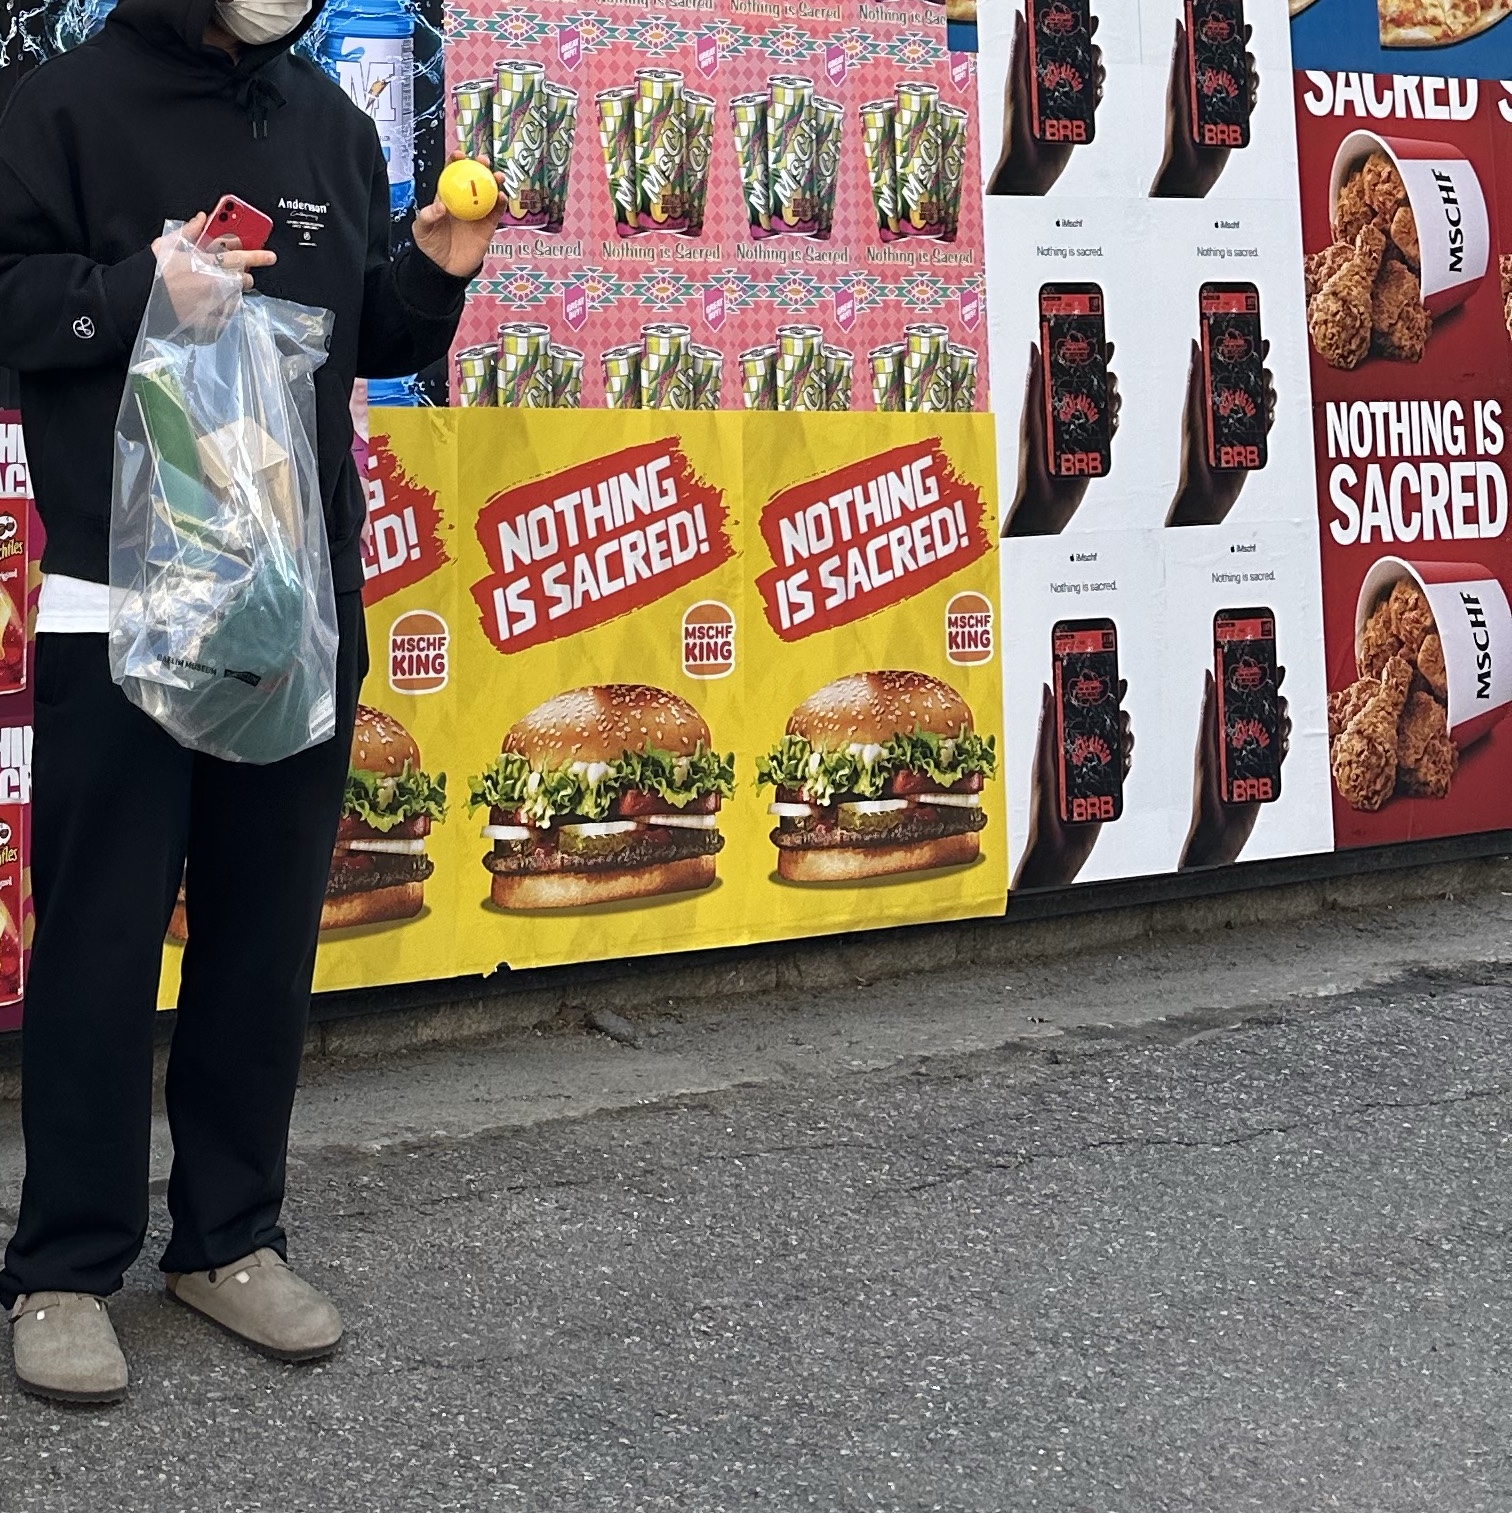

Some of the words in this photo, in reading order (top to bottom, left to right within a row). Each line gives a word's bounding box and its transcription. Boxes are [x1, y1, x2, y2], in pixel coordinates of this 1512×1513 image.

[784, 0, 796, 18] is
[796, 1, 842, 22] Sacred
[1304, 70, 1479, 121] SACRED
[1045, 119, 1086, 142] BRB
[1430, 168, 1465, 274] MSCHF
[603, 241, 658, 263] Nothing
[659, 244, 671, 262] is
[671, 242, 721, 263] Sacred
[1036, 245, 1067, 259] Nothing
[1068, 247, 1075, 256] is
[1326, 400, 1466, 458] NOTHING
[1474, 399, 1504, 455] IS
[779, 455, 940, 567] NOTHING
[1329, 461, 1509, 545] SACRED
[497, 456, 676, 574] NOTHING
[492, 578, 539, 641] IS
[547, 509, 710, 620] SACRED!
[775, 576, 816, 630] IS
[821, 500, 969, 610] SACRED!
[1211, 571, 1242, 585] Nothing
[1242, 573, 1249, 583] is
[684, 625, 735, 642] MSCHF
[947, 613, 990, 631] MSCHF
[392, 636, 447, 654] MSCHF
[947, 629, 990, 650] KING
[1459, 589, 1491, 700] MSCHF
[684, 641, 733, 664] KING
[392, 653, 446, 677] KING
